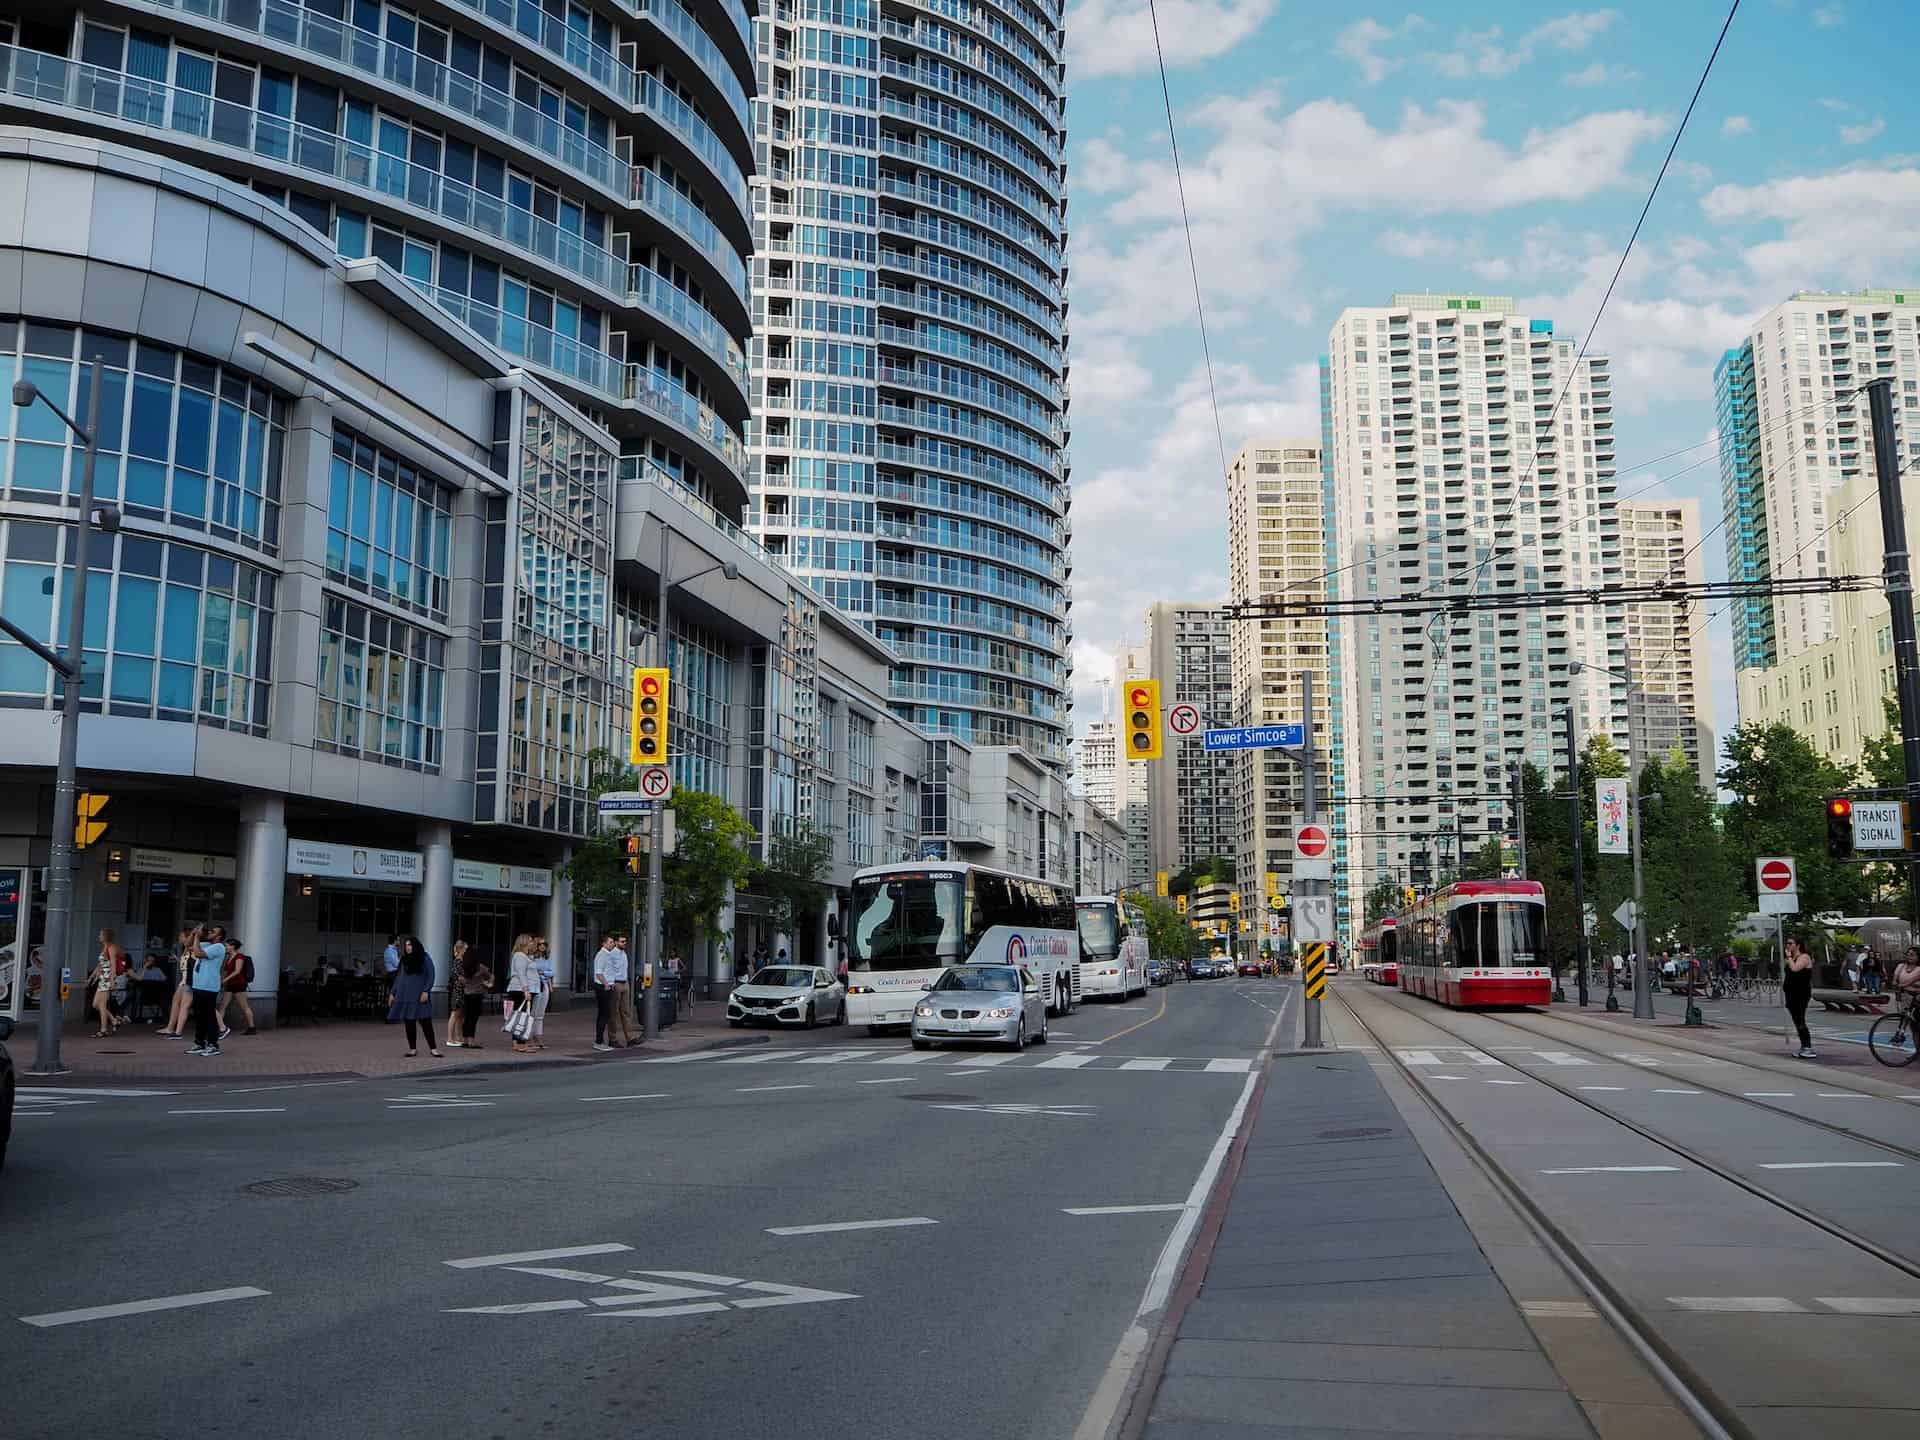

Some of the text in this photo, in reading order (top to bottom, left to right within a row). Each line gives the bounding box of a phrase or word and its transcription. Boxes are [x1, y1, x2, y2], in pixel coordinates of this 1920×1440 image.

[1208, 731, 1240, 745] Lower
[1244, 728, 1287, 744] Simcoe
[1855, 810, 1897, 822] TRANSIT
[1860, 828, 1896, 841] SIGNAL
[1030, 935, 1069, 956] Coach Canada
[878, 977, 929, 986] Coach Canada
